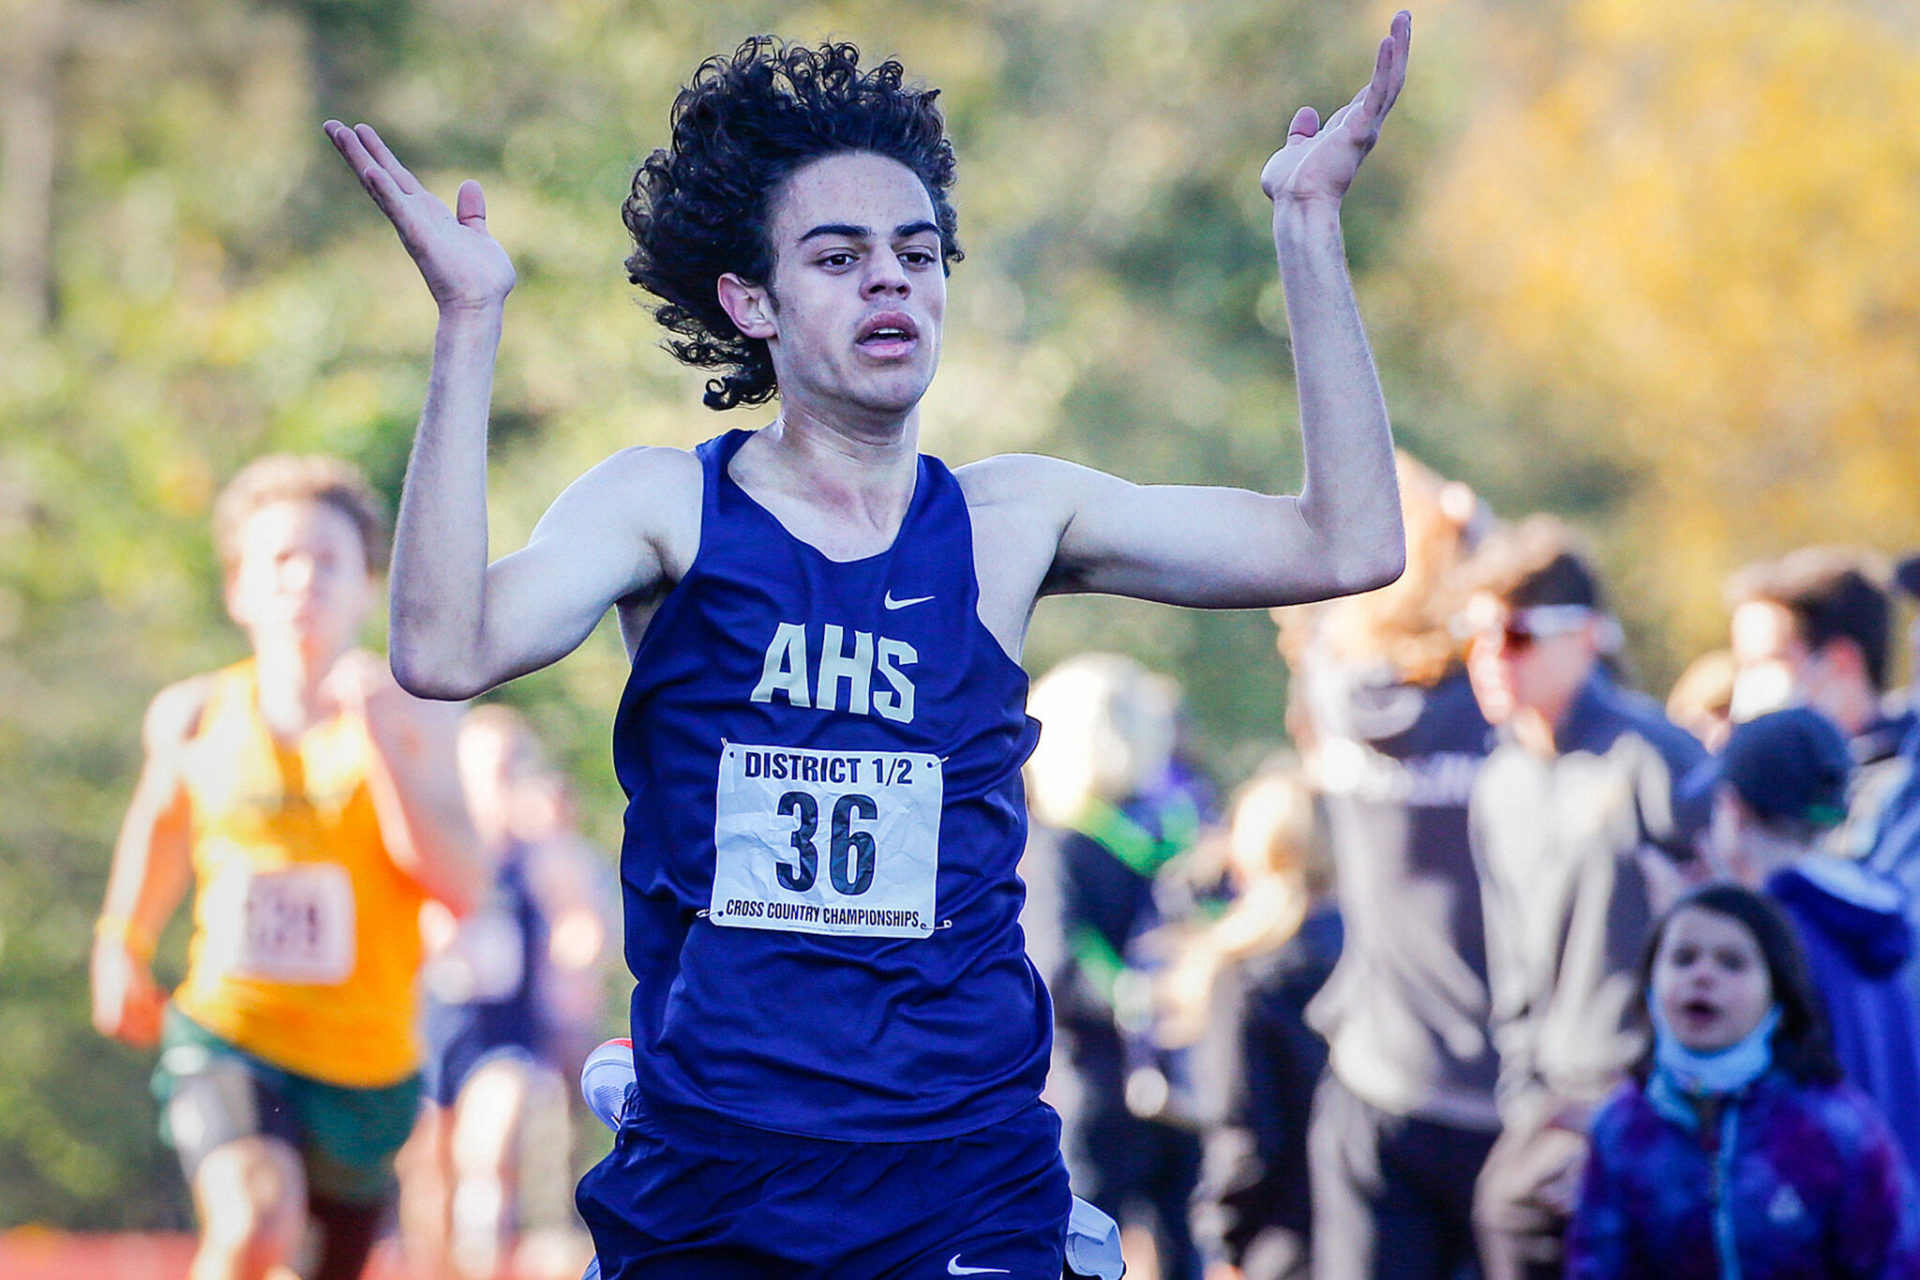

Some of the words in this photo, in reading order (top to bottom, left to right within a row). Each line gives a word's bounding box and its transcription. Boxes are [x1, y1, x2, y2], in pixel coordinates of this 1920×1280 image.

[750, 622, 918, 724] AHS
[744, 752, 861, 783] DISTRICT
[872, 758, 913, 787] 1/2
[775, 791, 878, 896] 36
[726, 899, 764, 917] CROSS
[767, 903, 820, 923] COUNTRY
[823, 909, 919, 928] CHAMPIONSHIPS
